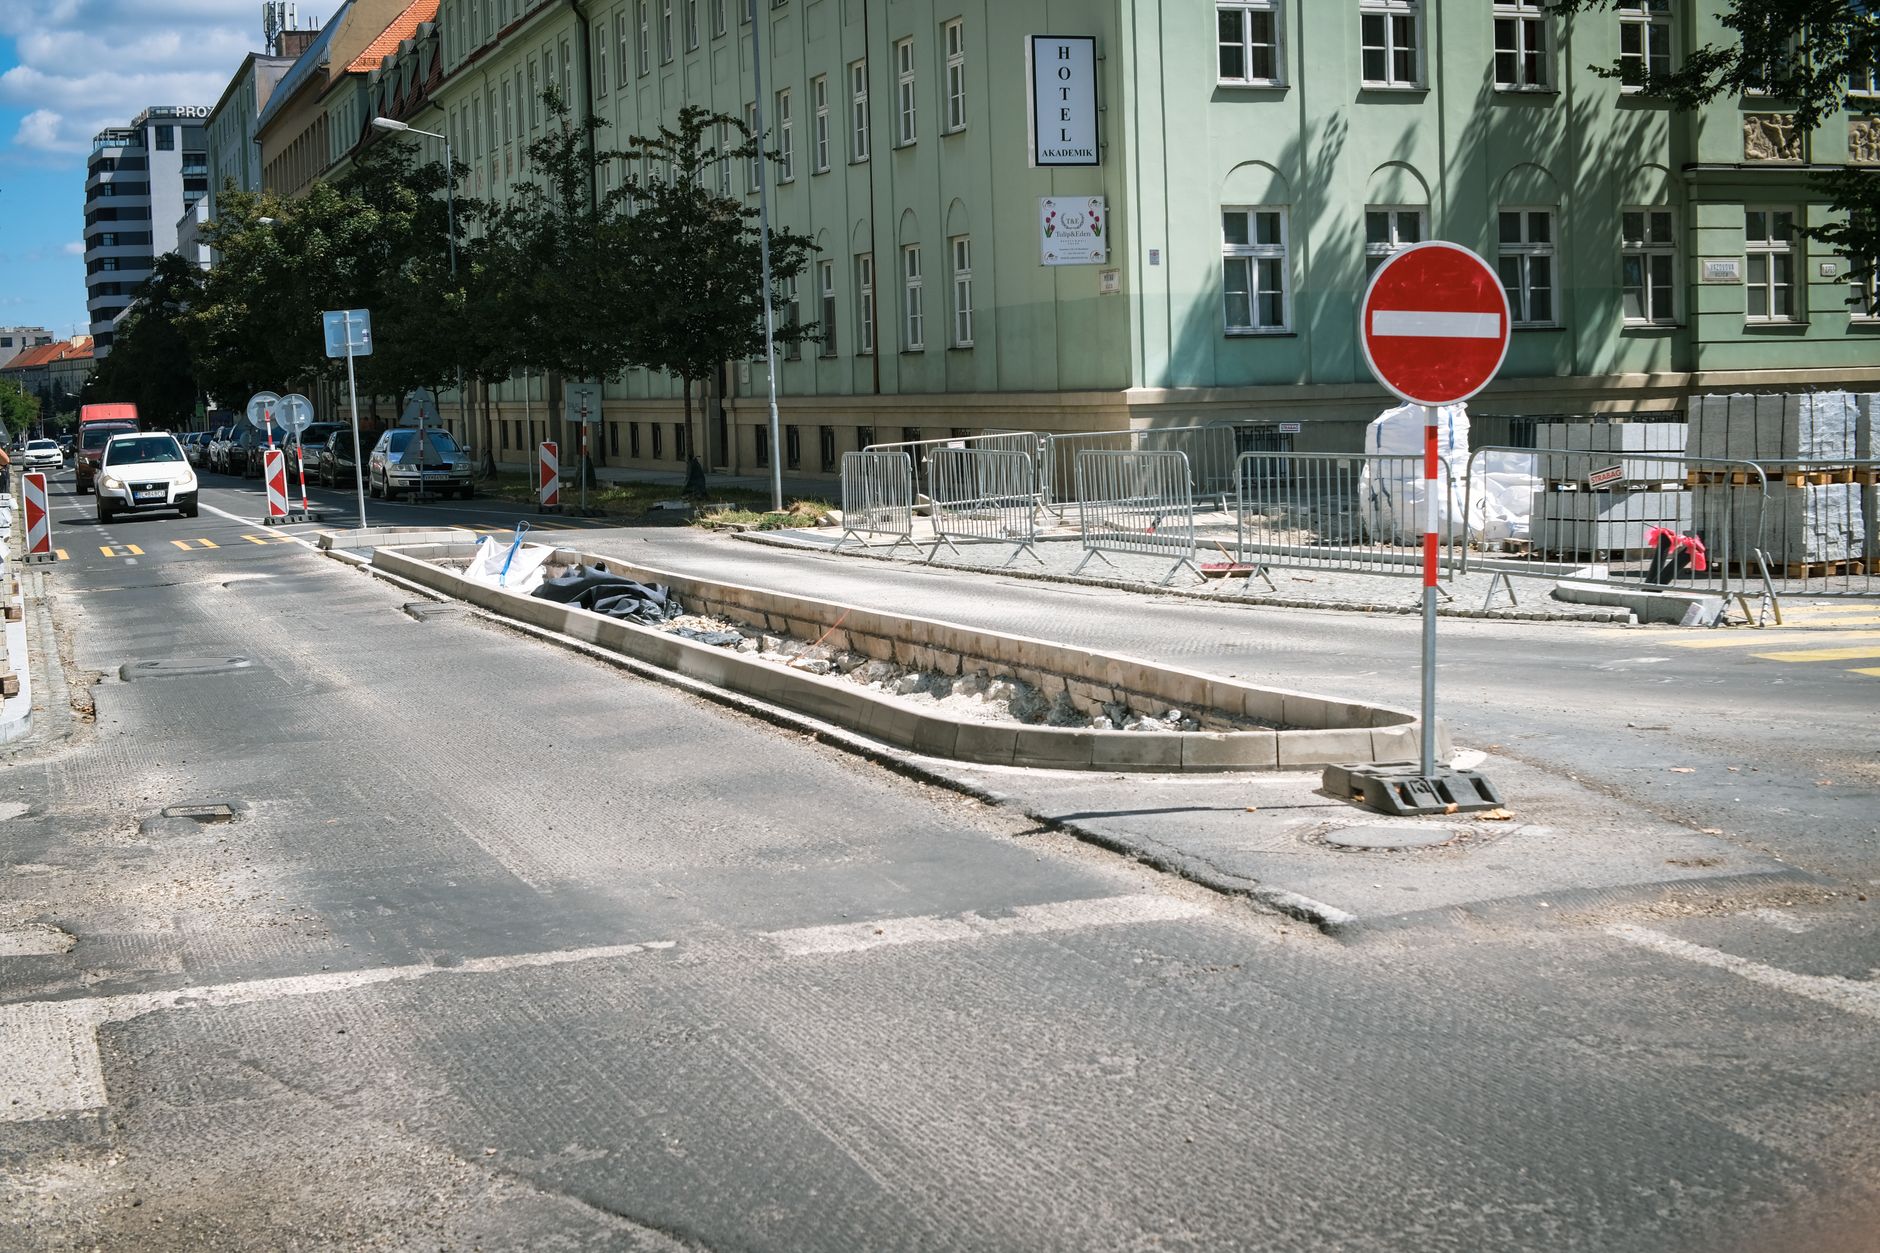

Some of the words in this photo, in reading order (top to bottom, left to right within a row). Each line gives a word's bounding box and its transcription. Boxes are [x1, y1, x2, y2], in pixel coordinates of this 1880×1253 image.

[1057, 46, 1072, 142] HOTEL
[176, 106, 214, 118] PRO
[1042, 149, 1093, 157] AKADEMIK
[1591, 469, 1622, 484] STRABAG
